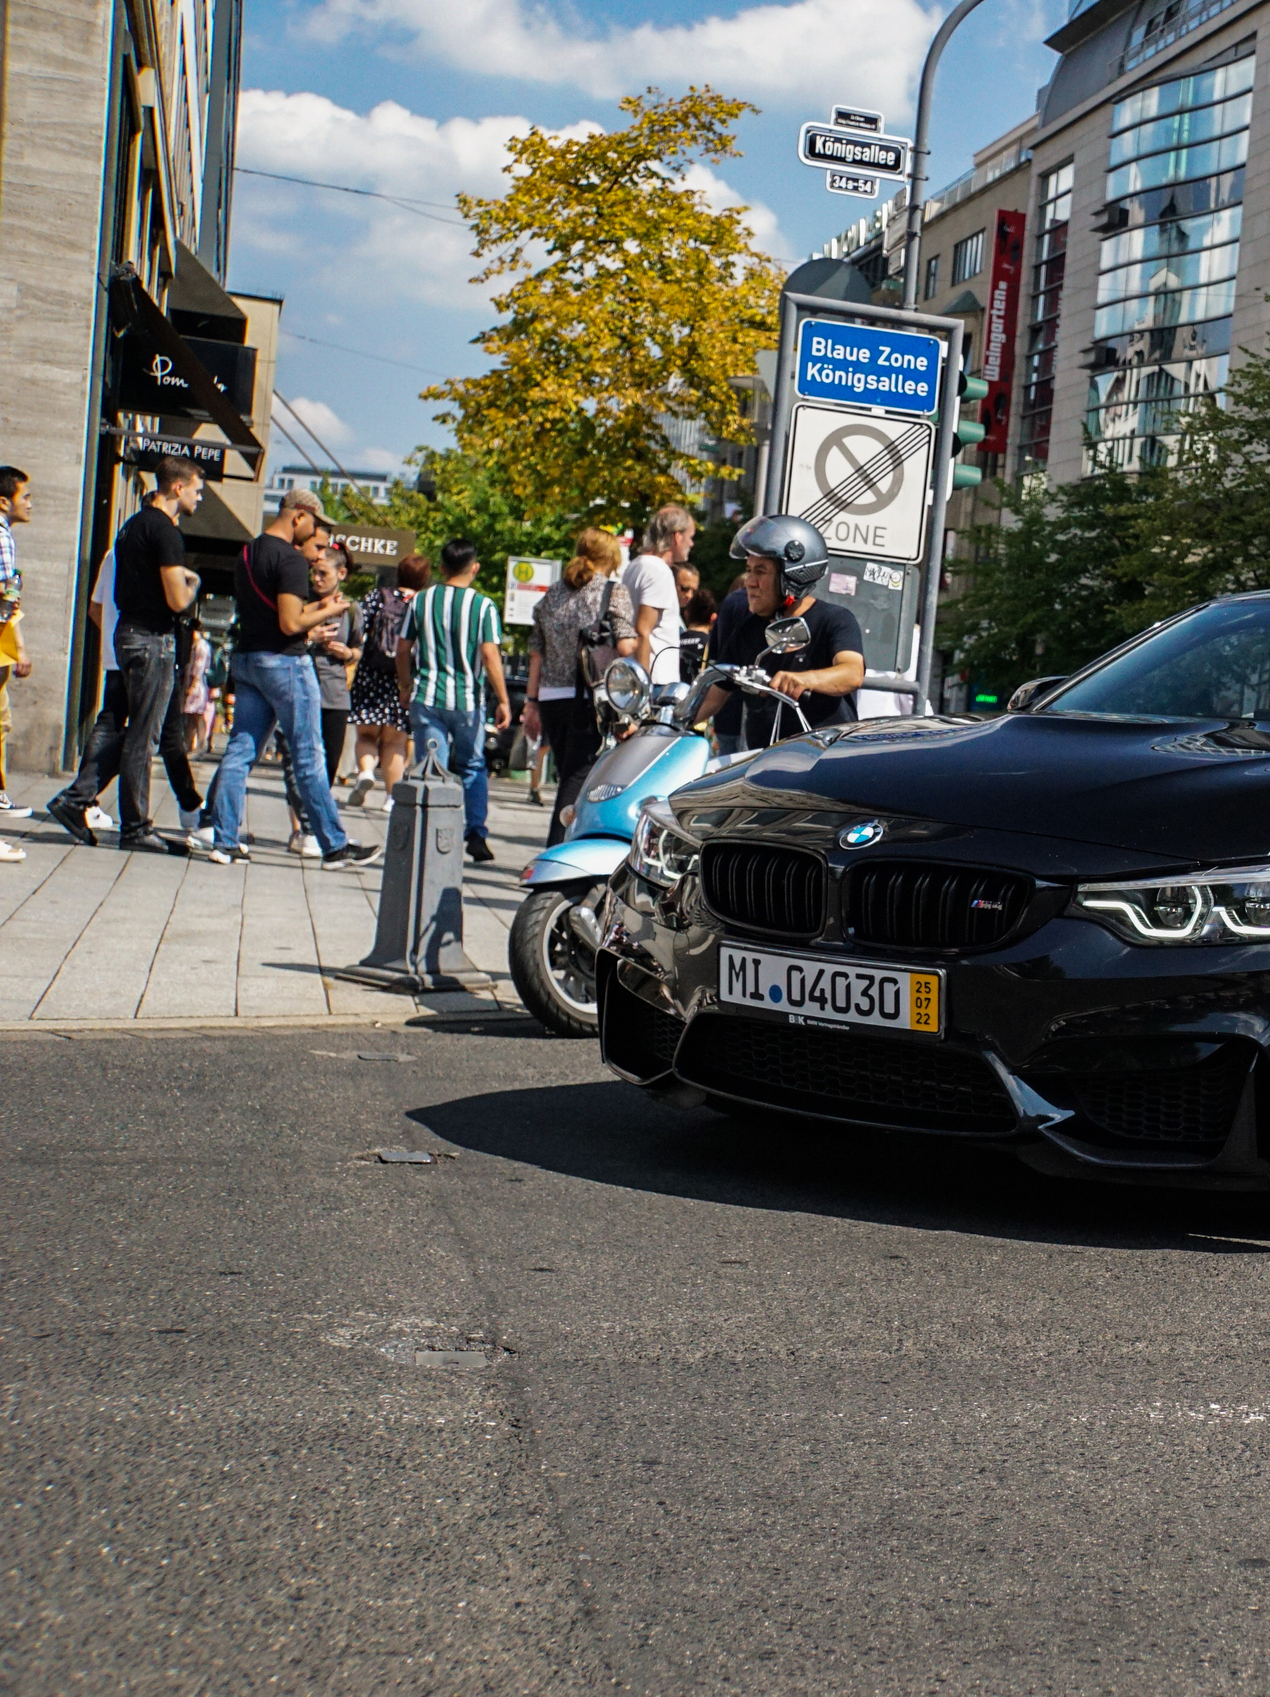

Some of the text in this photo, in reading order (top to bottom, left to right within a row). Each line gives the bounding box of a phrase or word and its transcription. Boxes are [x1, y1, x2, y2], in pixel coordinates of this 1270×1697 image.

[815, 135, 896, 166] Königsallee
[832, 175, 872, 193] 34a-54
[811, 336, 928, 371] Blaue Zone
[806, 361, 929, 397] Königsallee
[143, 438, 222, 462] PATRIZIA PEPE
[820, 518, 887, 548] ZONE
[728, 954, 901, 1021] MI 04030
[915, 981, 931, 994] 25
[915, 997, 931, 1010] 07
[915, 1012, 931, 1025] 22
